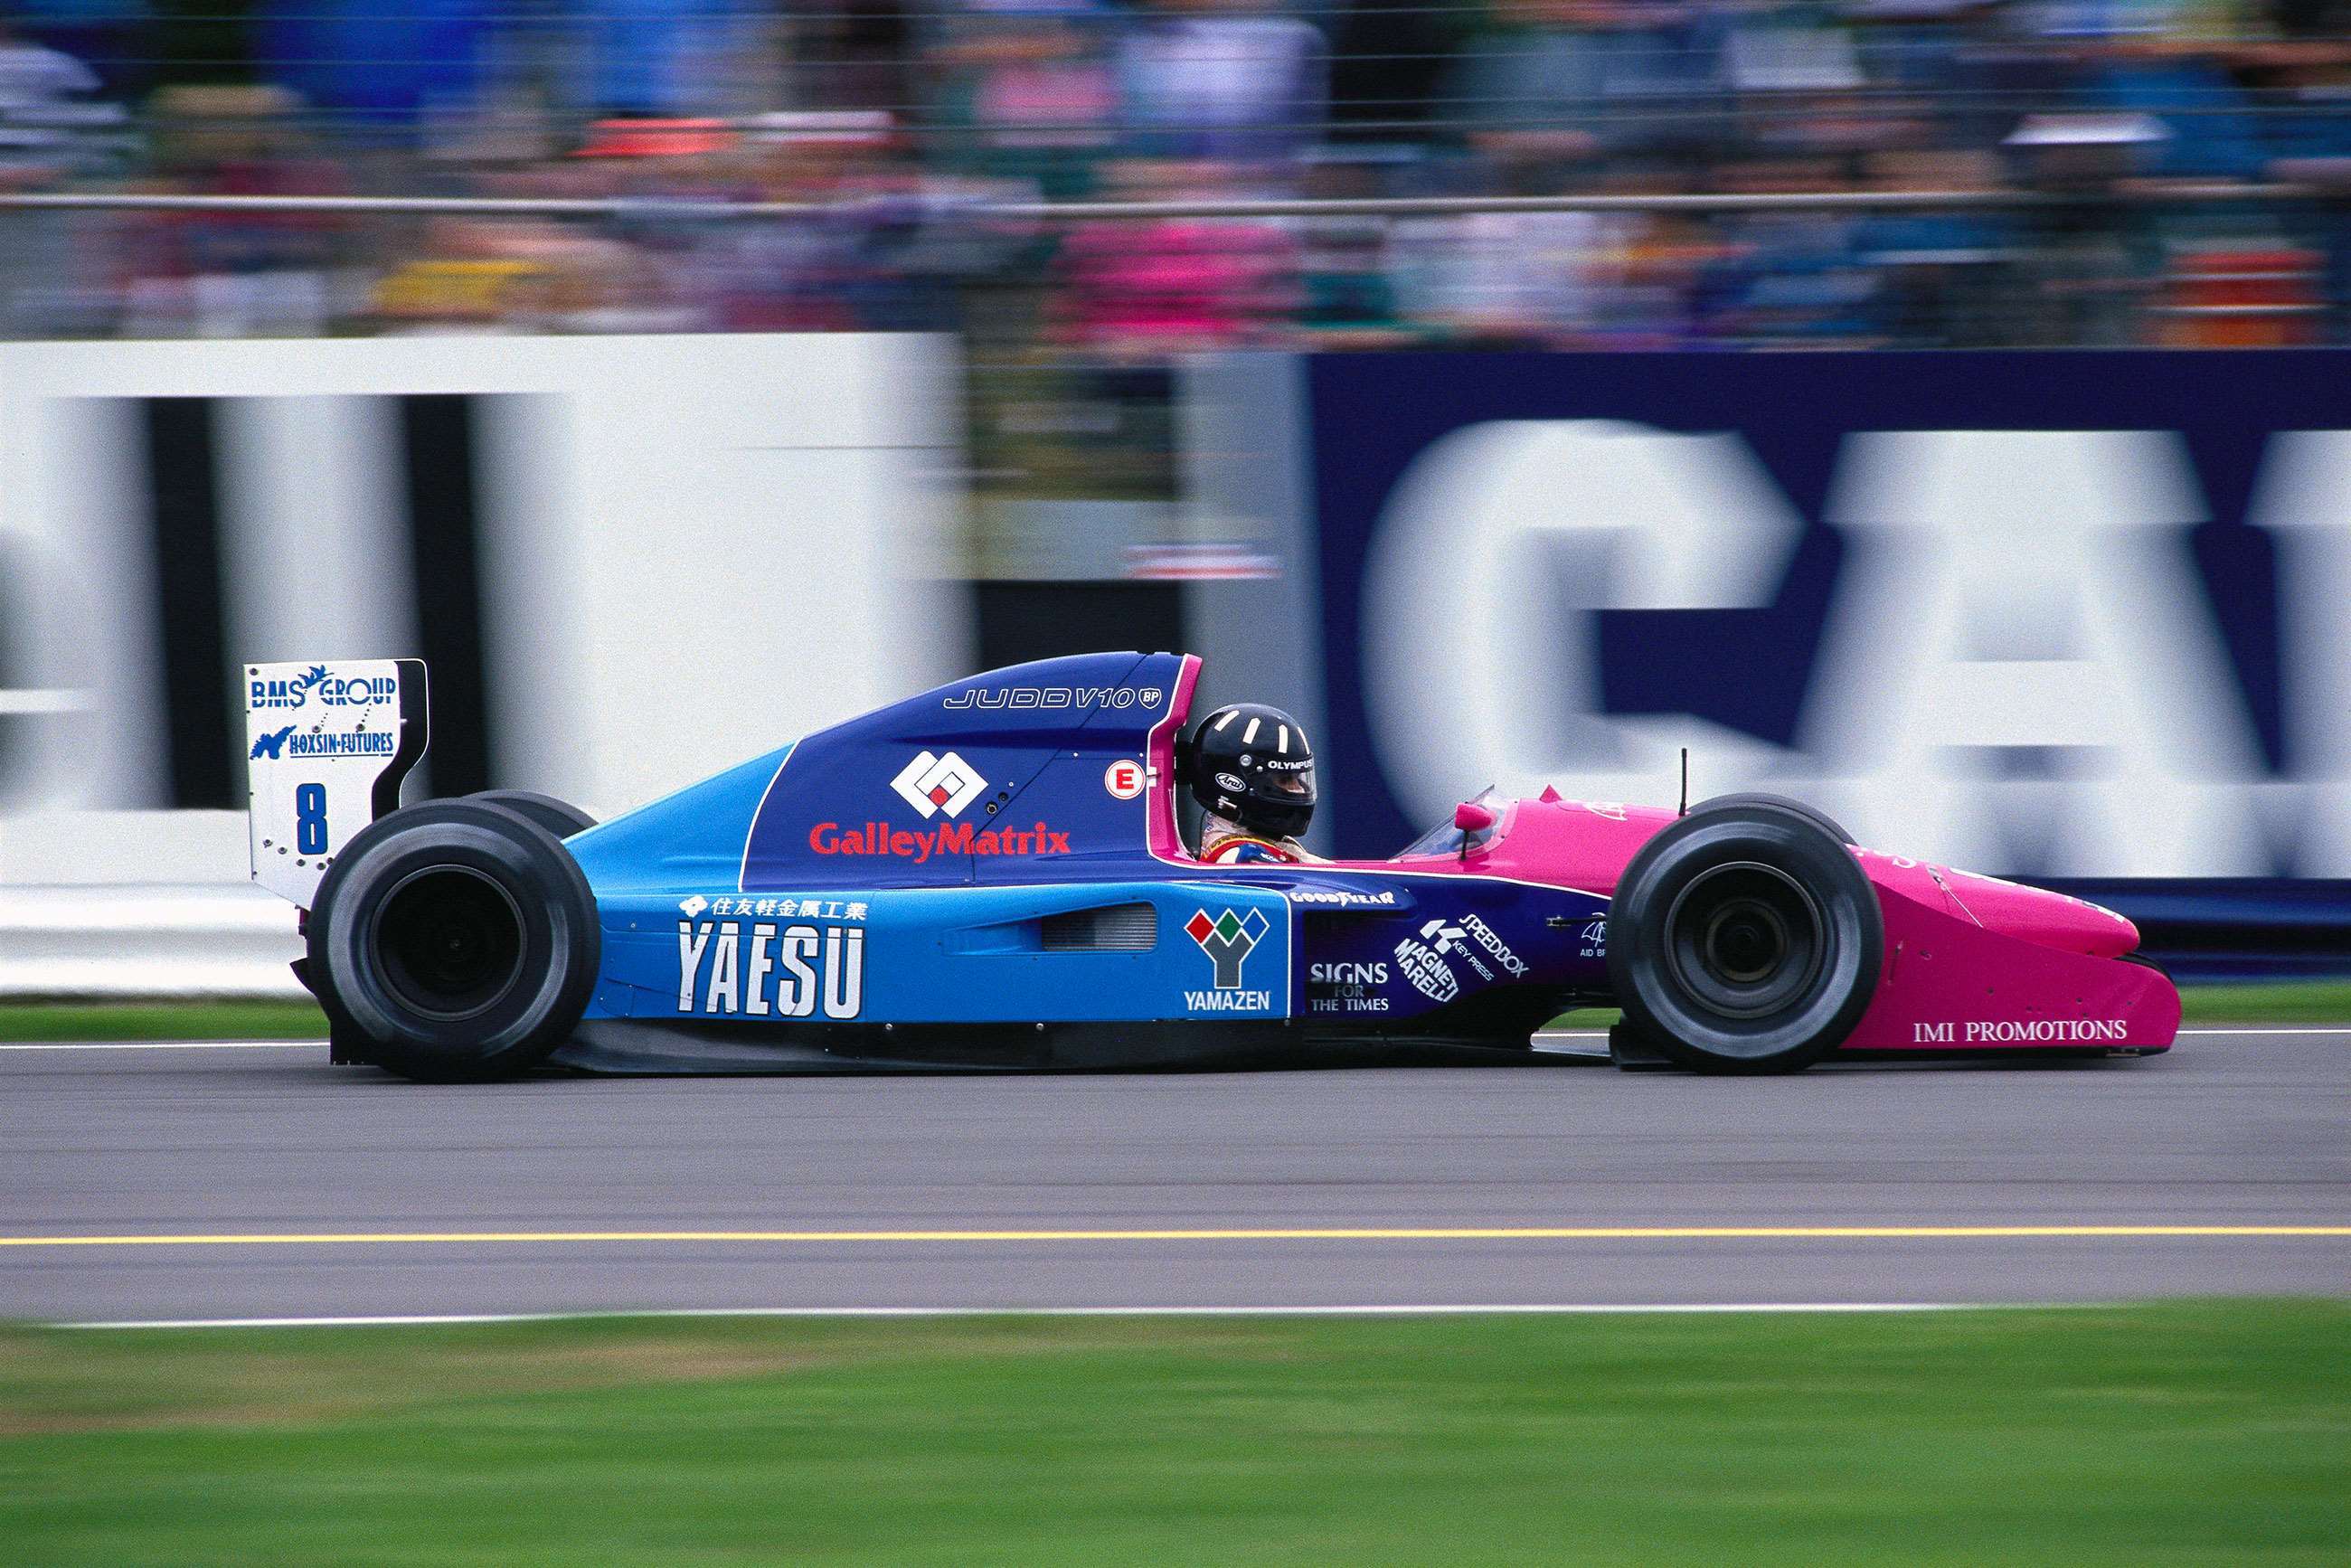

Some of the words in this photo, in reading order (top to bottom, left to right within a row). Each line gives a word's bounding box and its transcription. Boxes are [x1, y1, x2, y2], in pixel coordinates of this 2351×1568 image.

[1356, 419, 2351, 878] CA
[251, 681, 306, 708] BMS
[319, 678, 396, 704] GROUP
[943, 688, 1072, 709] JUDD
[1075, 688, 1136, 709] V10
[1268, 759, 1314, 770] OLYMPUS
[1116, 769, 1134, 789] E
[297, 783, 328, 855] 8
[809, 822, 1071, 863] GalleyMatrix
[711, 897, 868, 920] 住友軽金属工業
[1289, 891, 1395, 907] GOODYEAR
[1452, 940, 1470, 958] KEY
[1468, 956, 1495, 981] PRESS
[1580, 949, 1594, 957] AID
[678, 921, 864, 1019] YAESU
[1310, 962, 1389, 985] SIGNS
[1393, 949, 1453, 1003] MARELLI
[1394, 938, 1459, 996] MAGNETI
[1185, 991, 1270, 1011] YAMAZEN
[1335, 985, 1364, 997] FOR
[1311, 999, 1339, 1011] THE
[1346, 998, 1389, 1011] TIMES
[1912, 1023, 1955, 1044] IMI
[1965, 1019, 2128, 1042] PROMOTIONS
